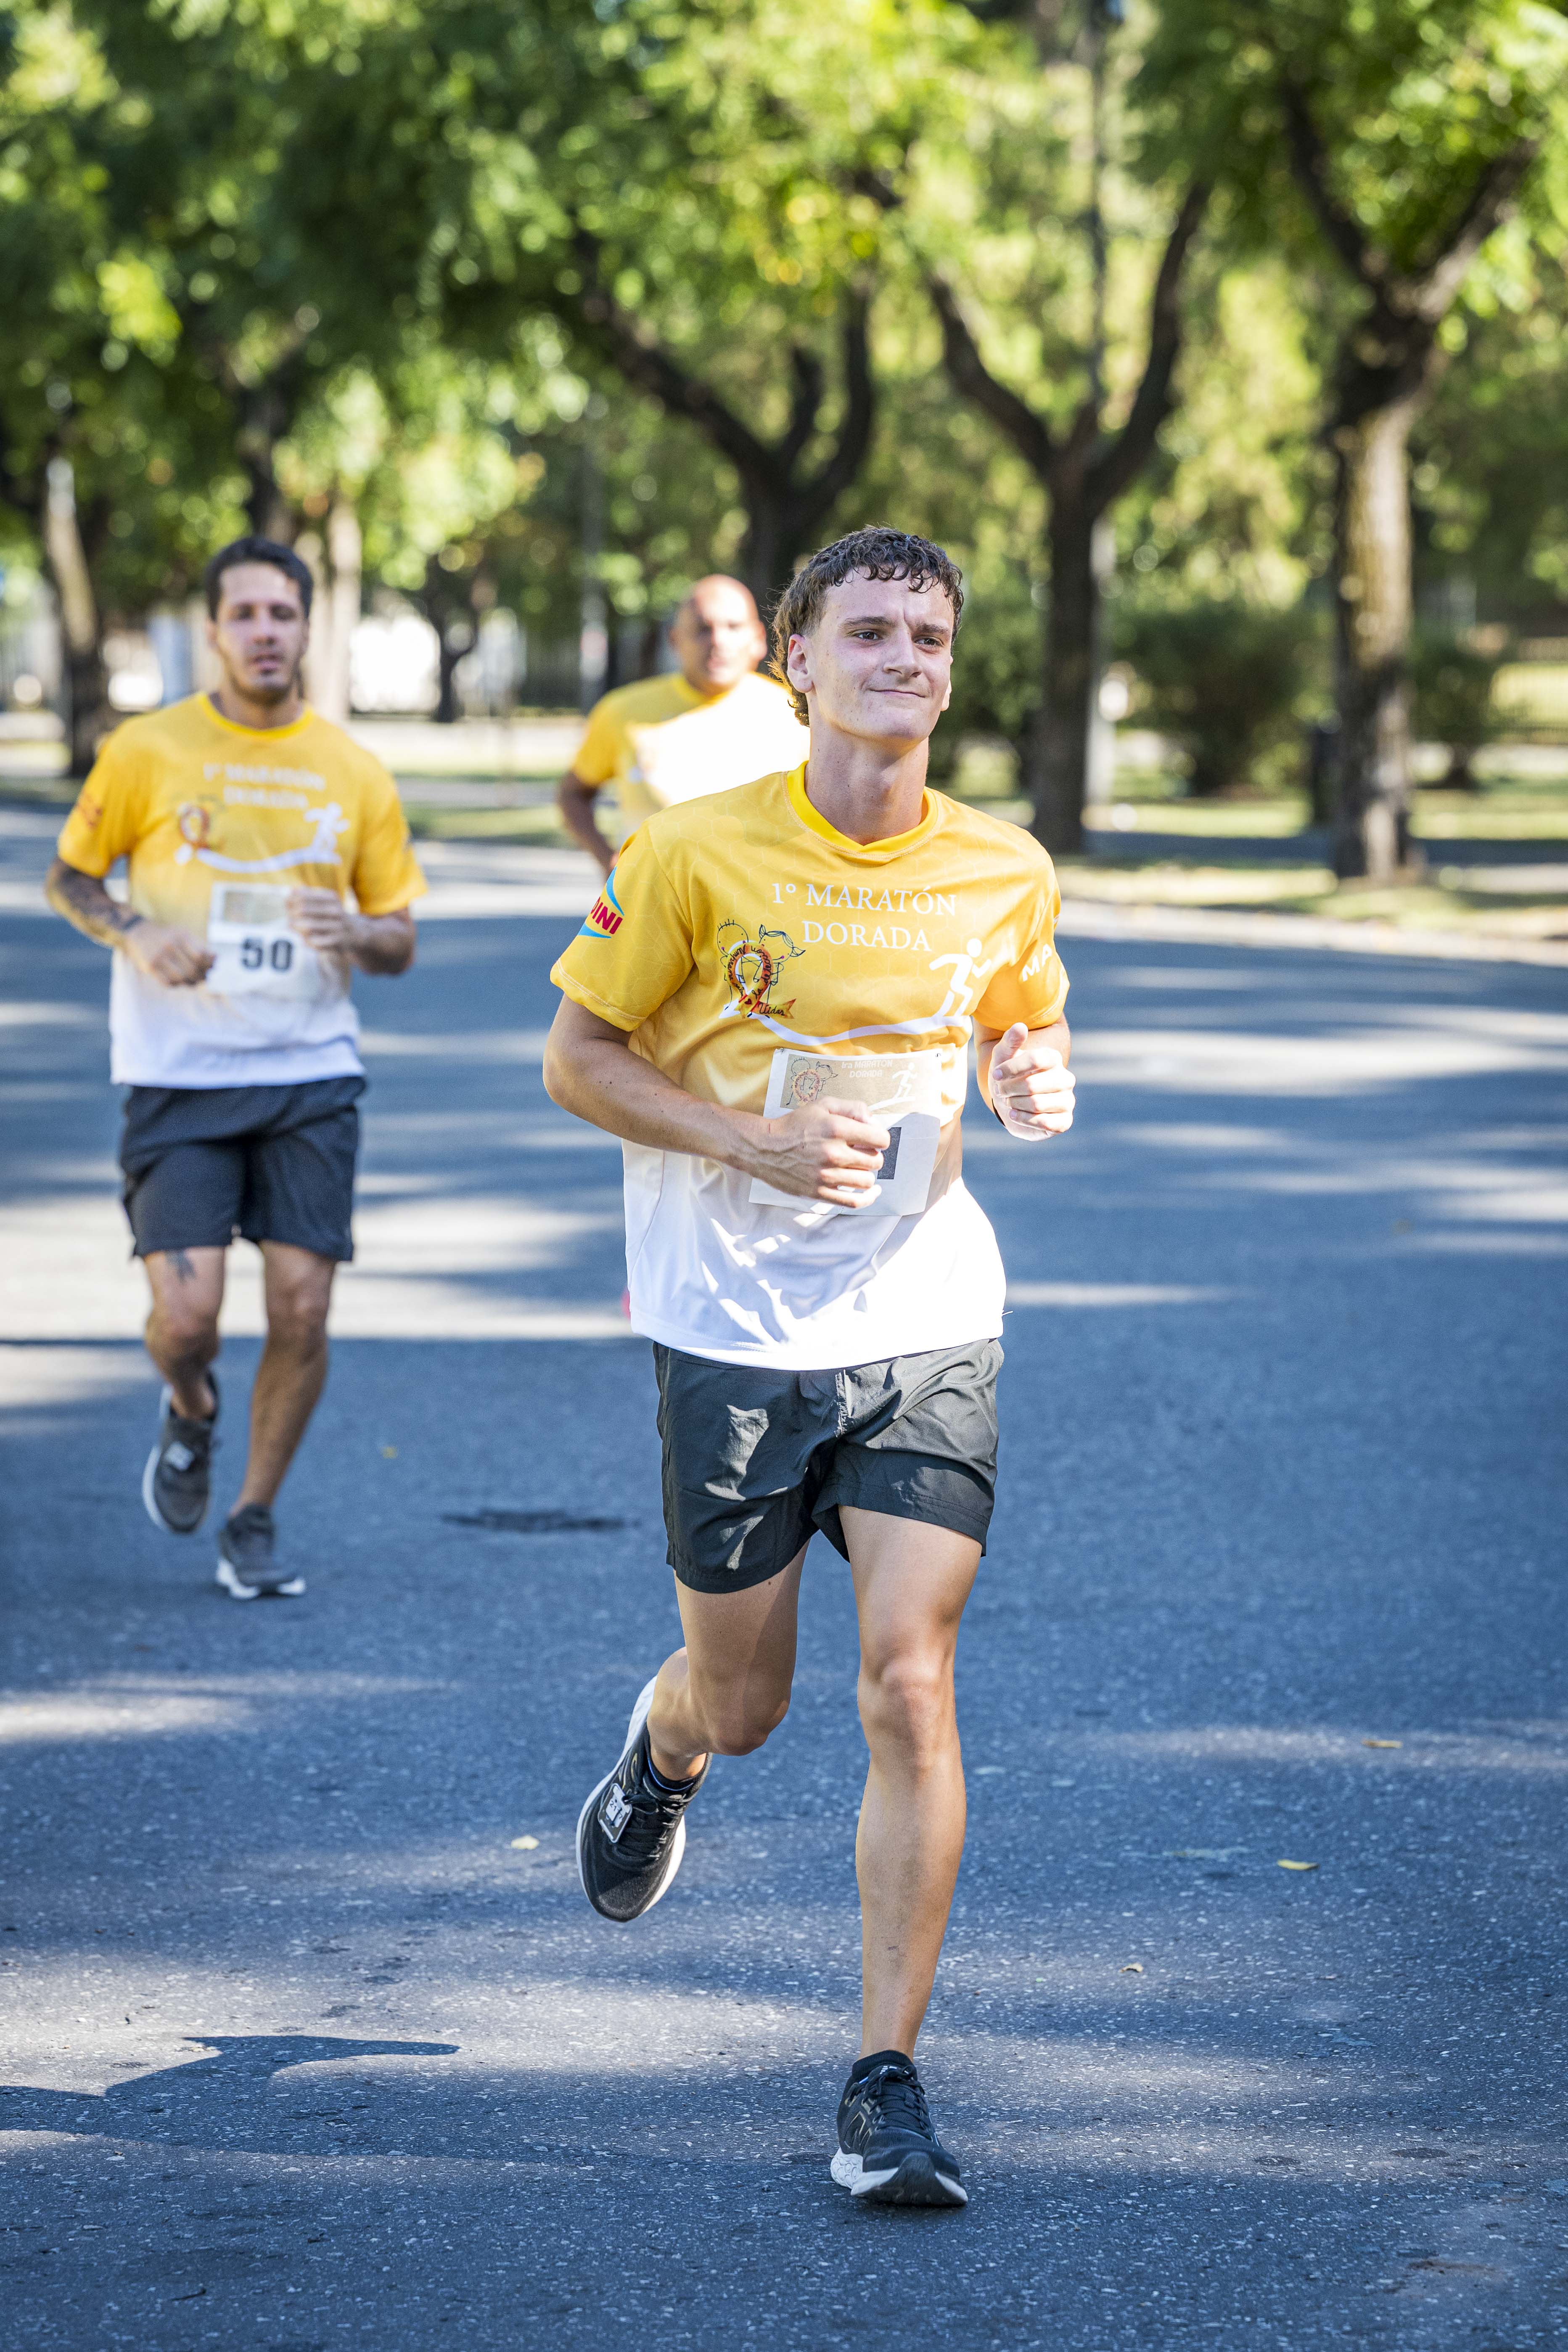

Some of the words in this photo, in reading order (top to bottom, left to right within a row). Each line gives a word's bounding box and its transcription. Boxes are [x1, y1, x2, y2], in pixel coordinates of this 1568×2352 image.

[805, 884, 957, 916] MARATÓN
[801, 920, 932, 952] DORADA
[241, 937, 294, 971] 50
